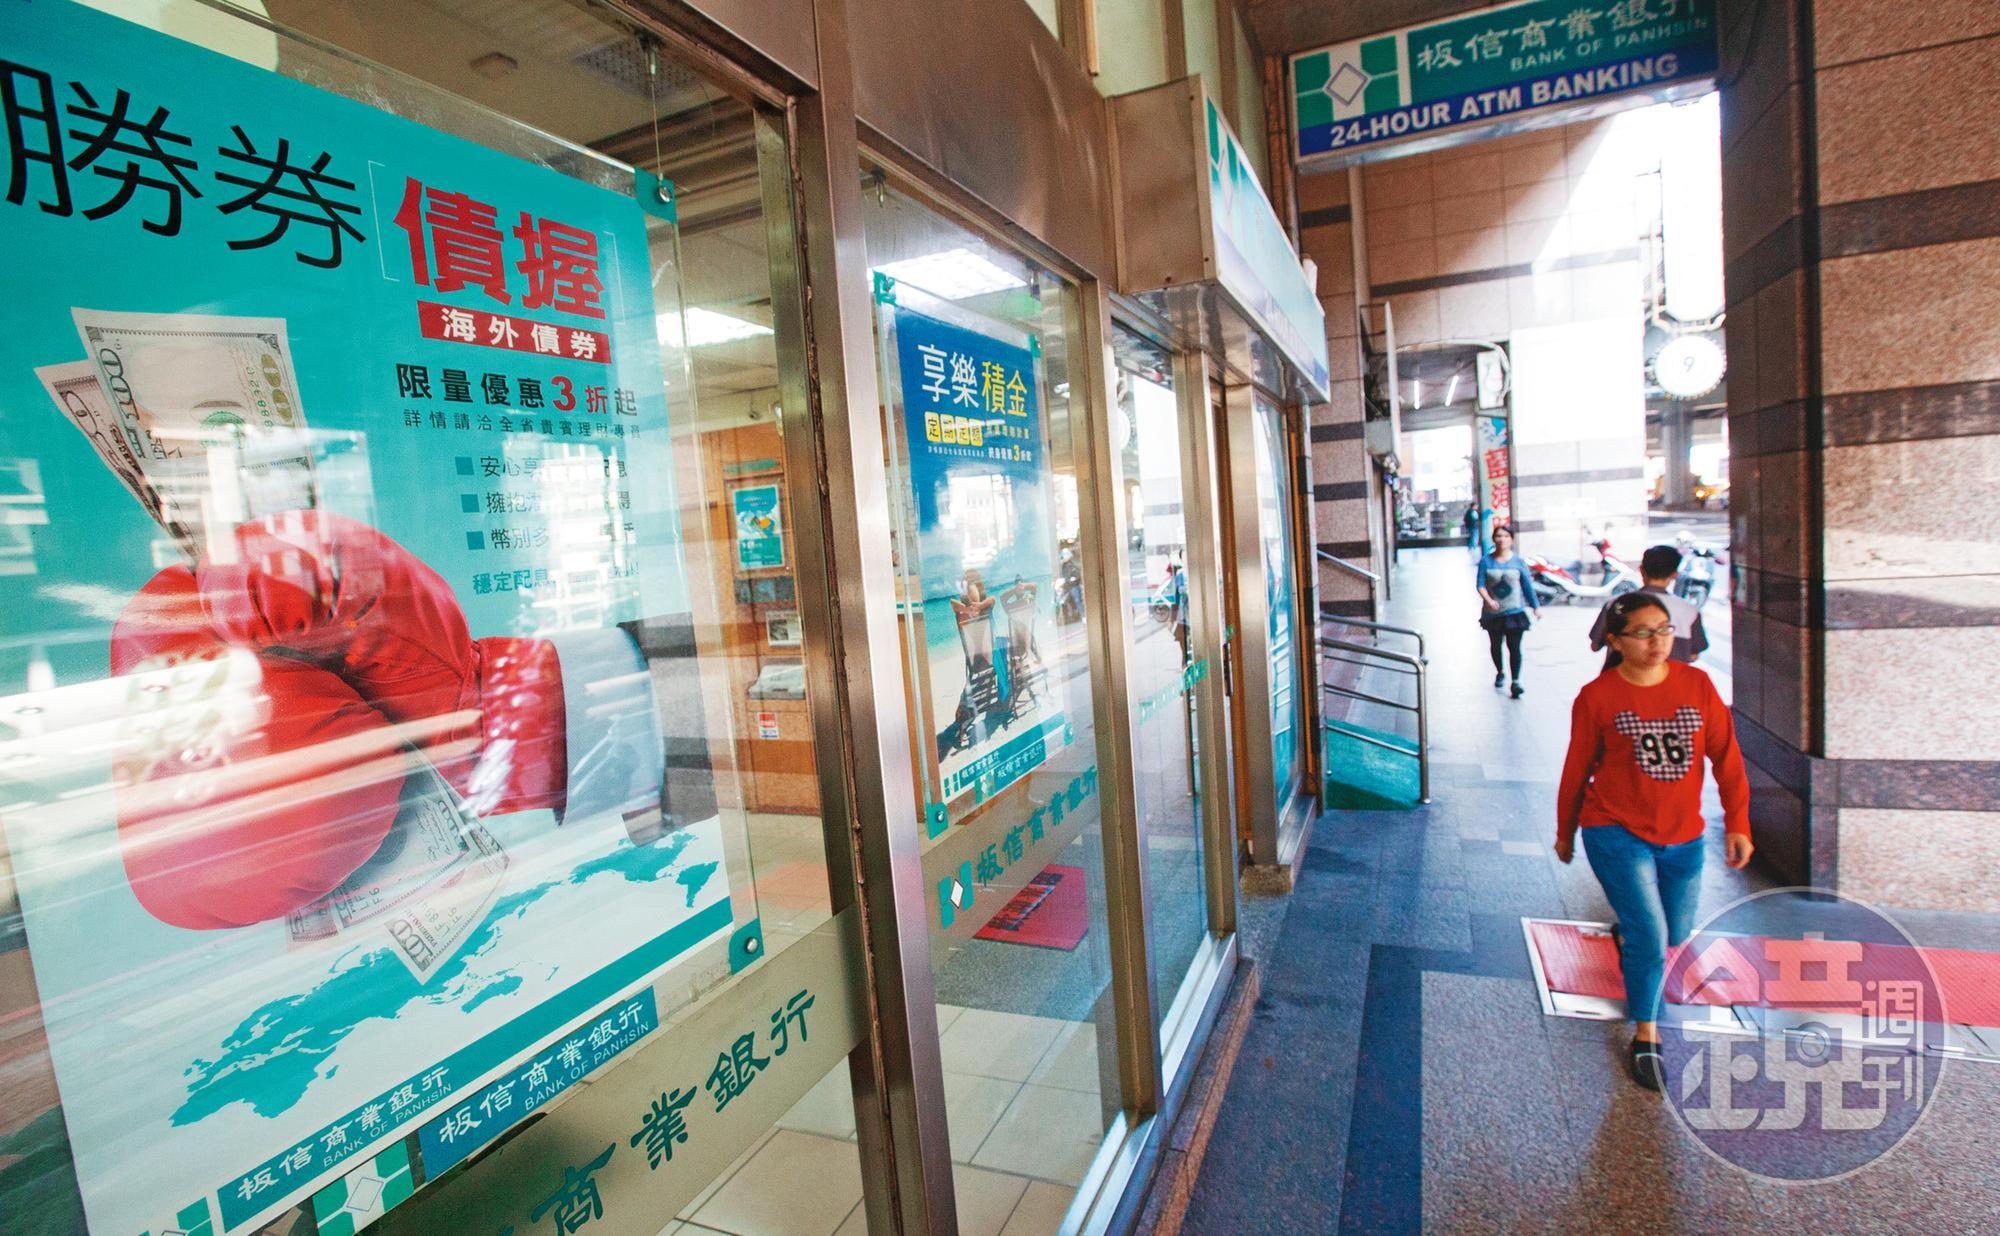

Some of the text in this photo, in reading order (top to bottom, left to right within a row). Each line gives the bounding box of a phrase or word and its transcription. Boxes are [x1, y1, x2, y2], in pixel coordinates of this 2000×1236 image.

[1510, 47, 1566, 72] BANK
[1576, 37, 1602, 56] OF
[1330, 52, 1680, 147] 24-HOUR ATM BANKING
[0, 59, 606, 321] 勝券 債握
[441, 307, 598, 360] 海外債券
[396, 362, 638, 417] 限量優惠3折起
[917, 343, 1028, 418] 享樂積金
[1640, 732, 1686, 766] 96
[438, 1001, 644, 1144] 板信商業銀行
[524, 1020, 650, 1112] BANK OF PANHSIN
[237, 1066, 449, 1201] 板信商業銀行
[323, 1083, 452, 1168] BANK OF PANHSIN
[499, 988, 816, 1236] 商業銀行
